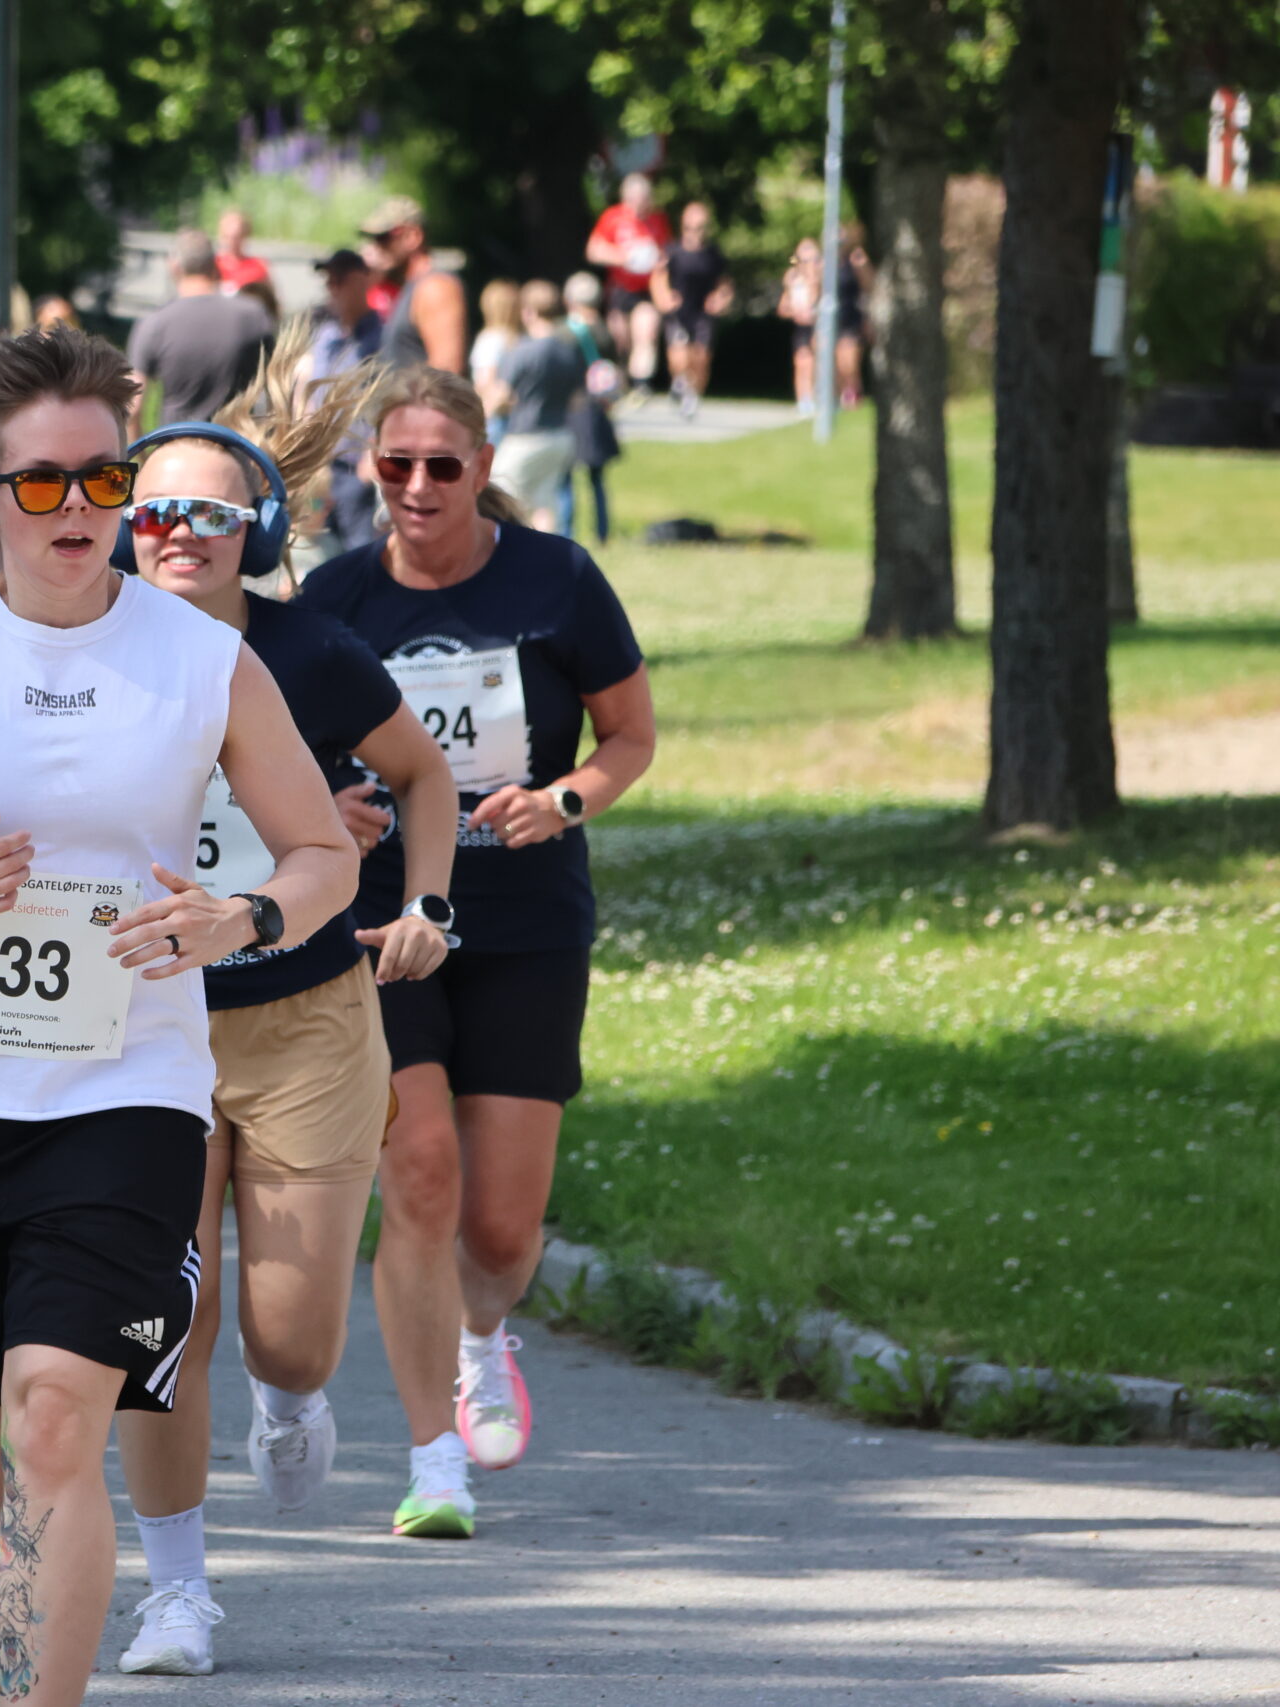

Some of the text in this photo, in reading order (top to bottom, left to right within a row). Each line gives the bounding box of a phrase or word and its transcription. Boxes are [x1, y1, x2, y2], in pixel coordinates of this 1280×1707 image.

[24, 685, 96, 709] GYMSHARK
[424, 706, 477, 750] 24
[196, 822, 219, 870] 5
[95, 884, 123, 896] 2025
[120, 1326, 162, 1352] adidas
